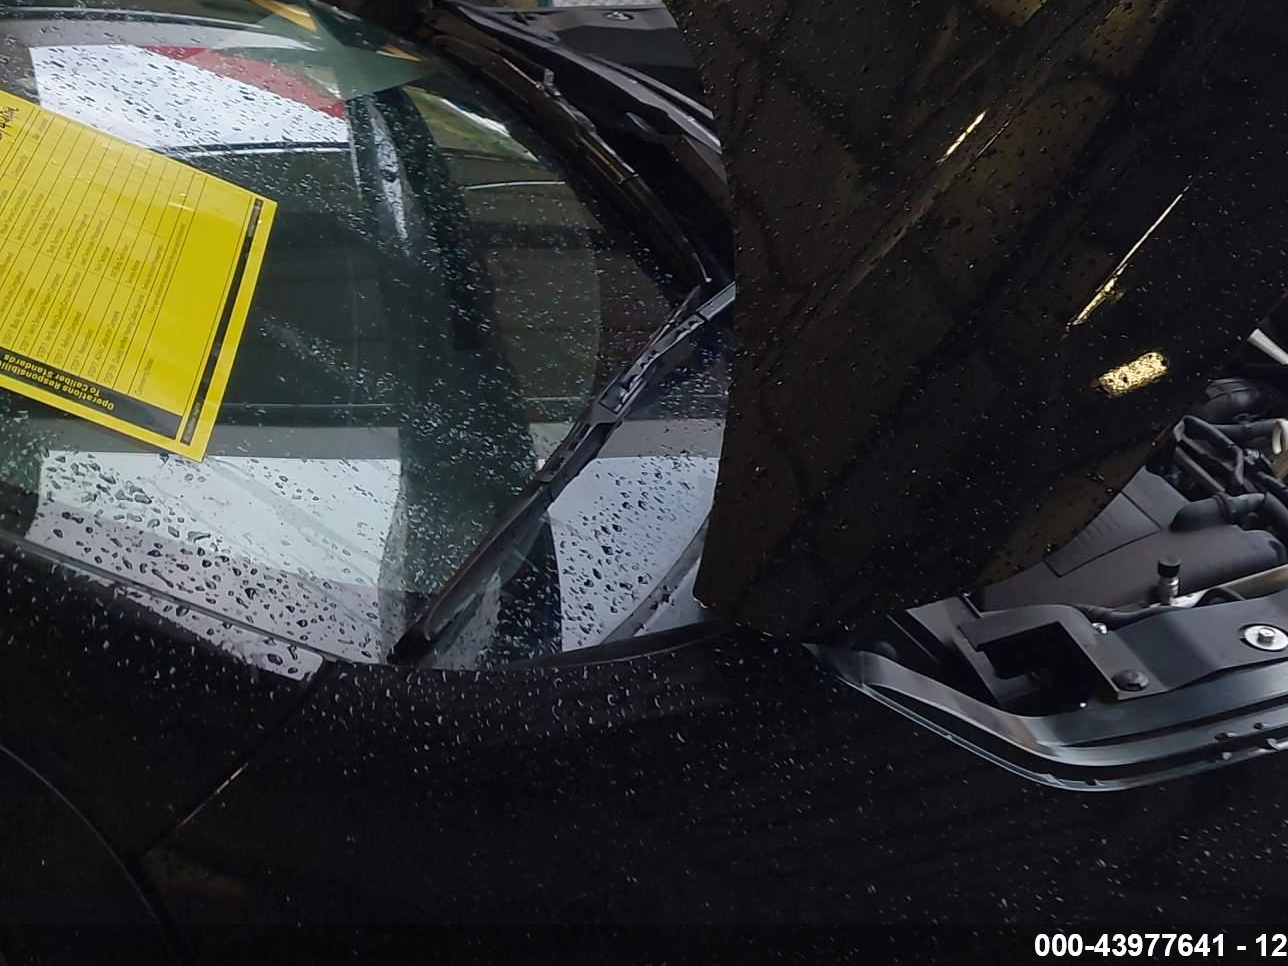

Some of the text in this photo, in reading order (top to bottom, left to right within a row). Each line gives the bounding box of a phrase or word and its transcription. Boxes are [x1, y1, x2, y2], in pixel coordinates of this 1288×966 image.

[3, 353, 101, 397] To Caliber Standards
[62, 384, 114, 411] Operations
